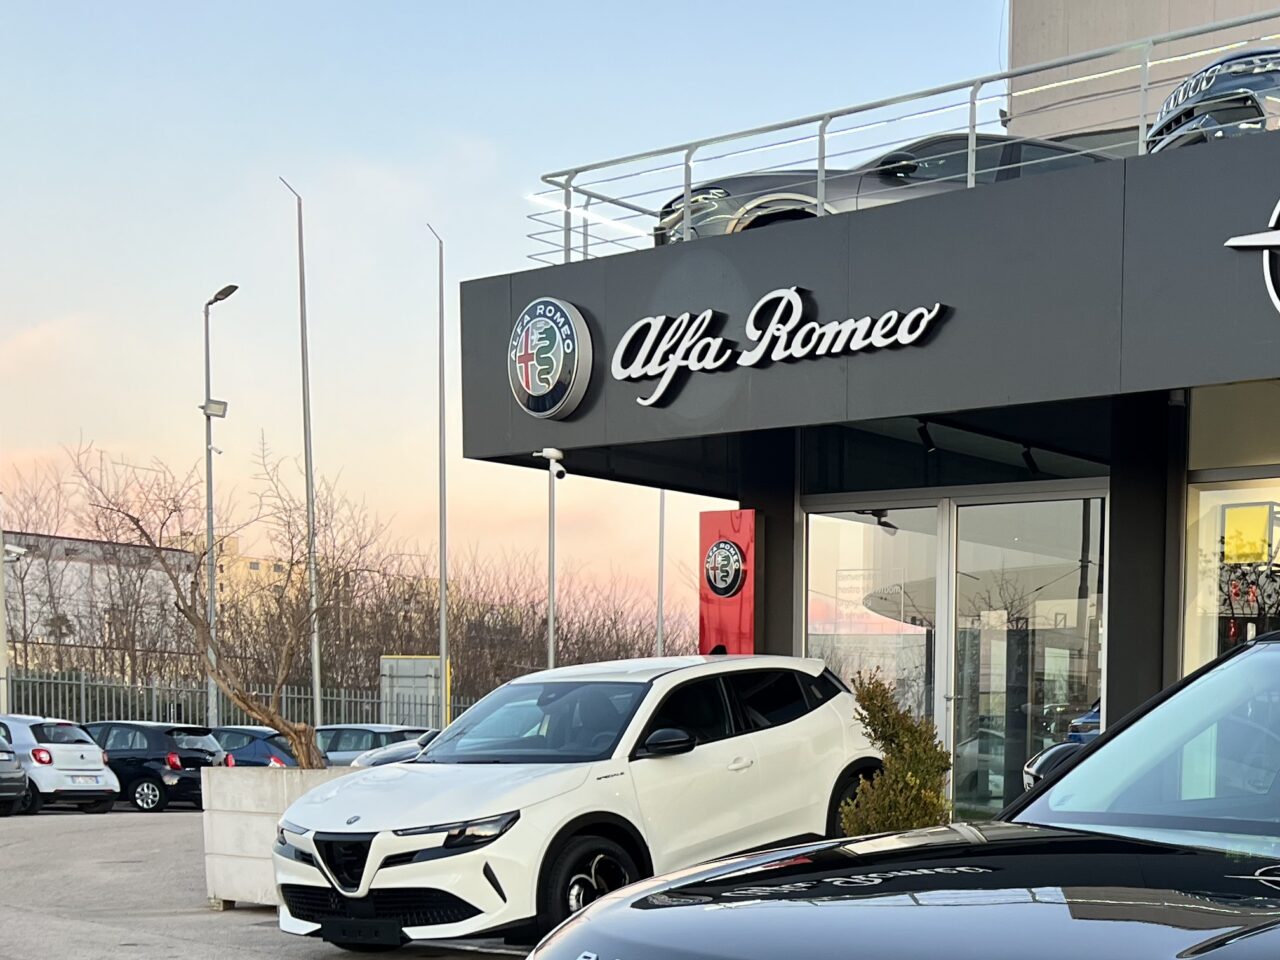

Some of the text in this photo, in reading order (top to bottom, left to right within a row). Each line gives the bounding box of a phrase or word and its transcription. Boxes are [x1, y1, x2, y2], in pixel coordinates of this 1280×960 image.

[510, 304, 574, 361] ALFA ROMEO
[610, 286, 942, 408] Alfa Romeo
